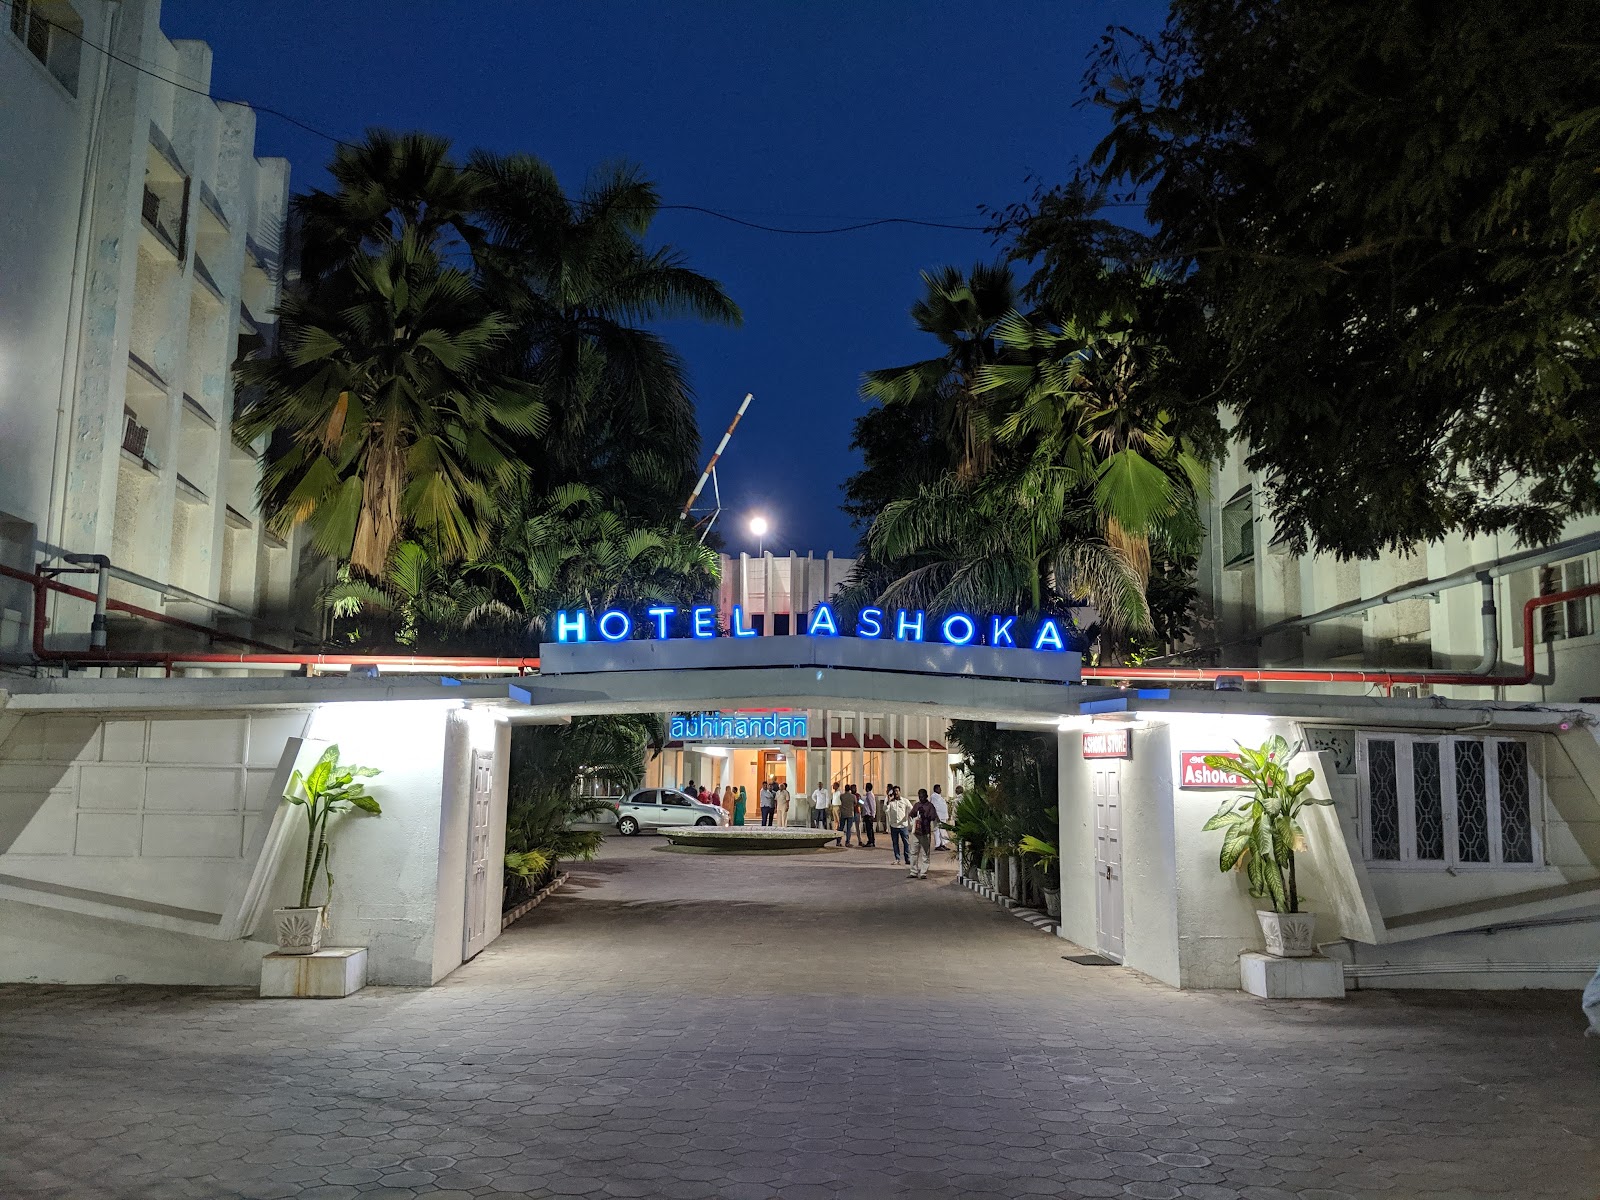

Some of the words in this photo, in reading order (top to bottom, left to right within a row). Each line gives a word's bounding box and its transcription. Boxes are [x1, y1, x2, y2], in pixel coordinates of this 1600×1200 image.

[558, 606, 756, 642] HOTEL
[809, 604, 1064, 650] ASHOKA
[1084, 735, 1106, 753] ASHOKA
[1107, 734, 1126, 753] STORE
[1185, 765, 1237, 783] Ashoka
